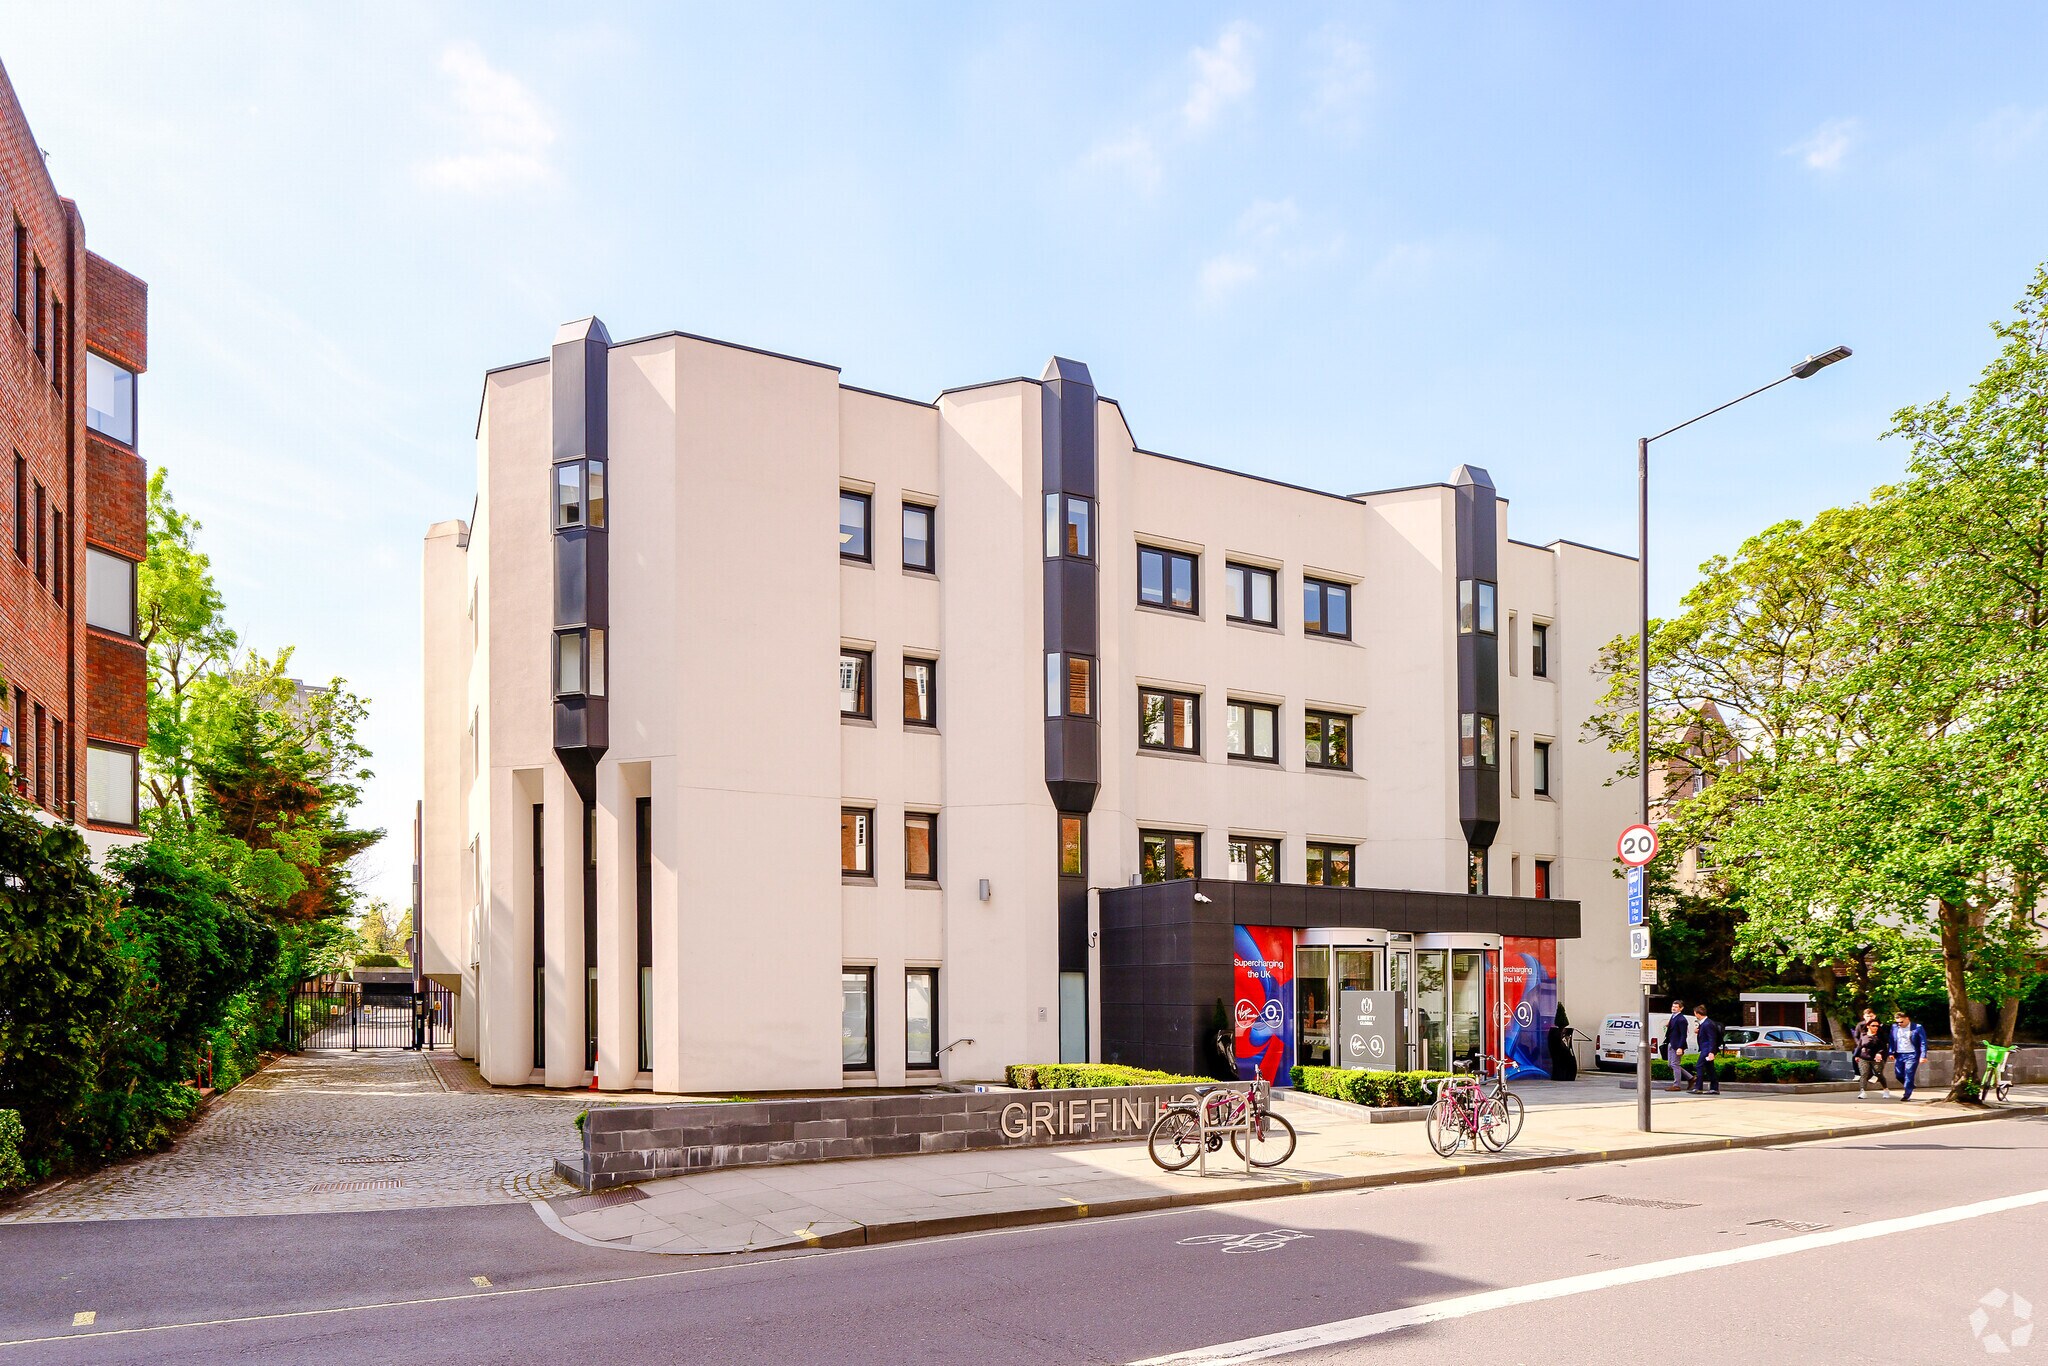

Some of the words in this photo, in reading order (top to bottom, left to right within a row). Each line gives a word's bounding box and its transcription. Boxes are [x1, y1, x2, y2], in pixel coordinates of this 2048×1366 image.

[1623, 835, 1652, 855] 20
[1234, 958, 1284, 970] Supercharging
[1247, 970, 1259, 978] the
[1260, 970, 1271, 978] UK
[1492, 965, 1533, 975] Sercharging
[1513, 975, 1523, 983] UK
[1000, 1096, 1143, 1139] GRIFFIN
